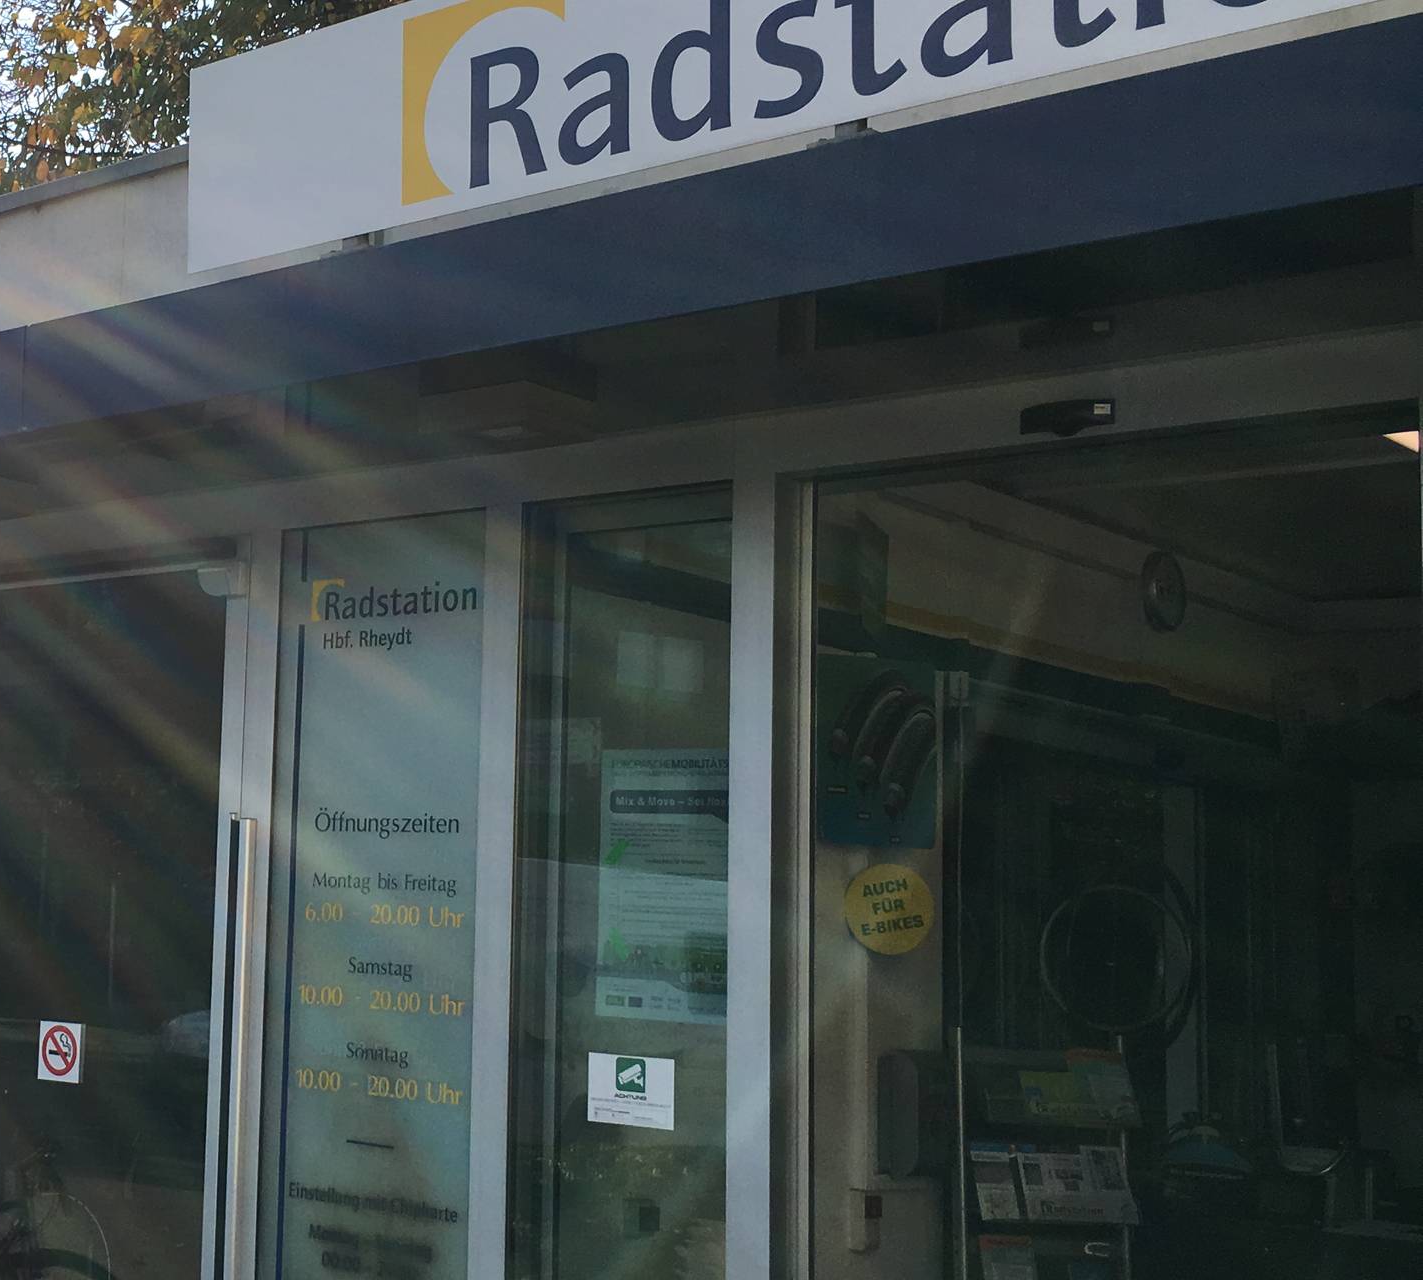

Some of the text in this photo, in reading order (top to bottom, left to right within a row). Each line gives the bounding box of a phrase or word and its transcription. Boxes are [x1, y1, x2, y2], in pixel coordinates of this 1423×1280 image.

[325, 581, 477, 620] Radstation
[323, 626, 412, 650] Hbf. Rheydt
[615, 796, 635, 807] Mix
[637, 796, 645, 807] &
[315, 807, 459, 839] Öffnungszeiten
[312, 872, 457, 897] Montag bis Freitag
[863, 878, 908, 897] AUCH
[305, 902, 343, 921] 6.00
[370, 904, 420, 926] 20.00
[429, 905, 465, 928] Uhr
[872, 897, 905, 915] FÜR
[861, 915, 924, 936] E-BIKES
[348, 957, 413, 982] Samstag
[298, 984, 343, 1006] 10.00
[369, 990, 421, 1012] 20.00
[429, 994, 465, 1016] Uhr
[346, 1042, 409, 1069] Sonntag
[295, 1068, 341, 1091] 10.00
[368, 1074, 418, 1100] 20.00
[427, 1082, 463, 1105] Uhr
[289, 1182, 360, 1212] Einstellung
